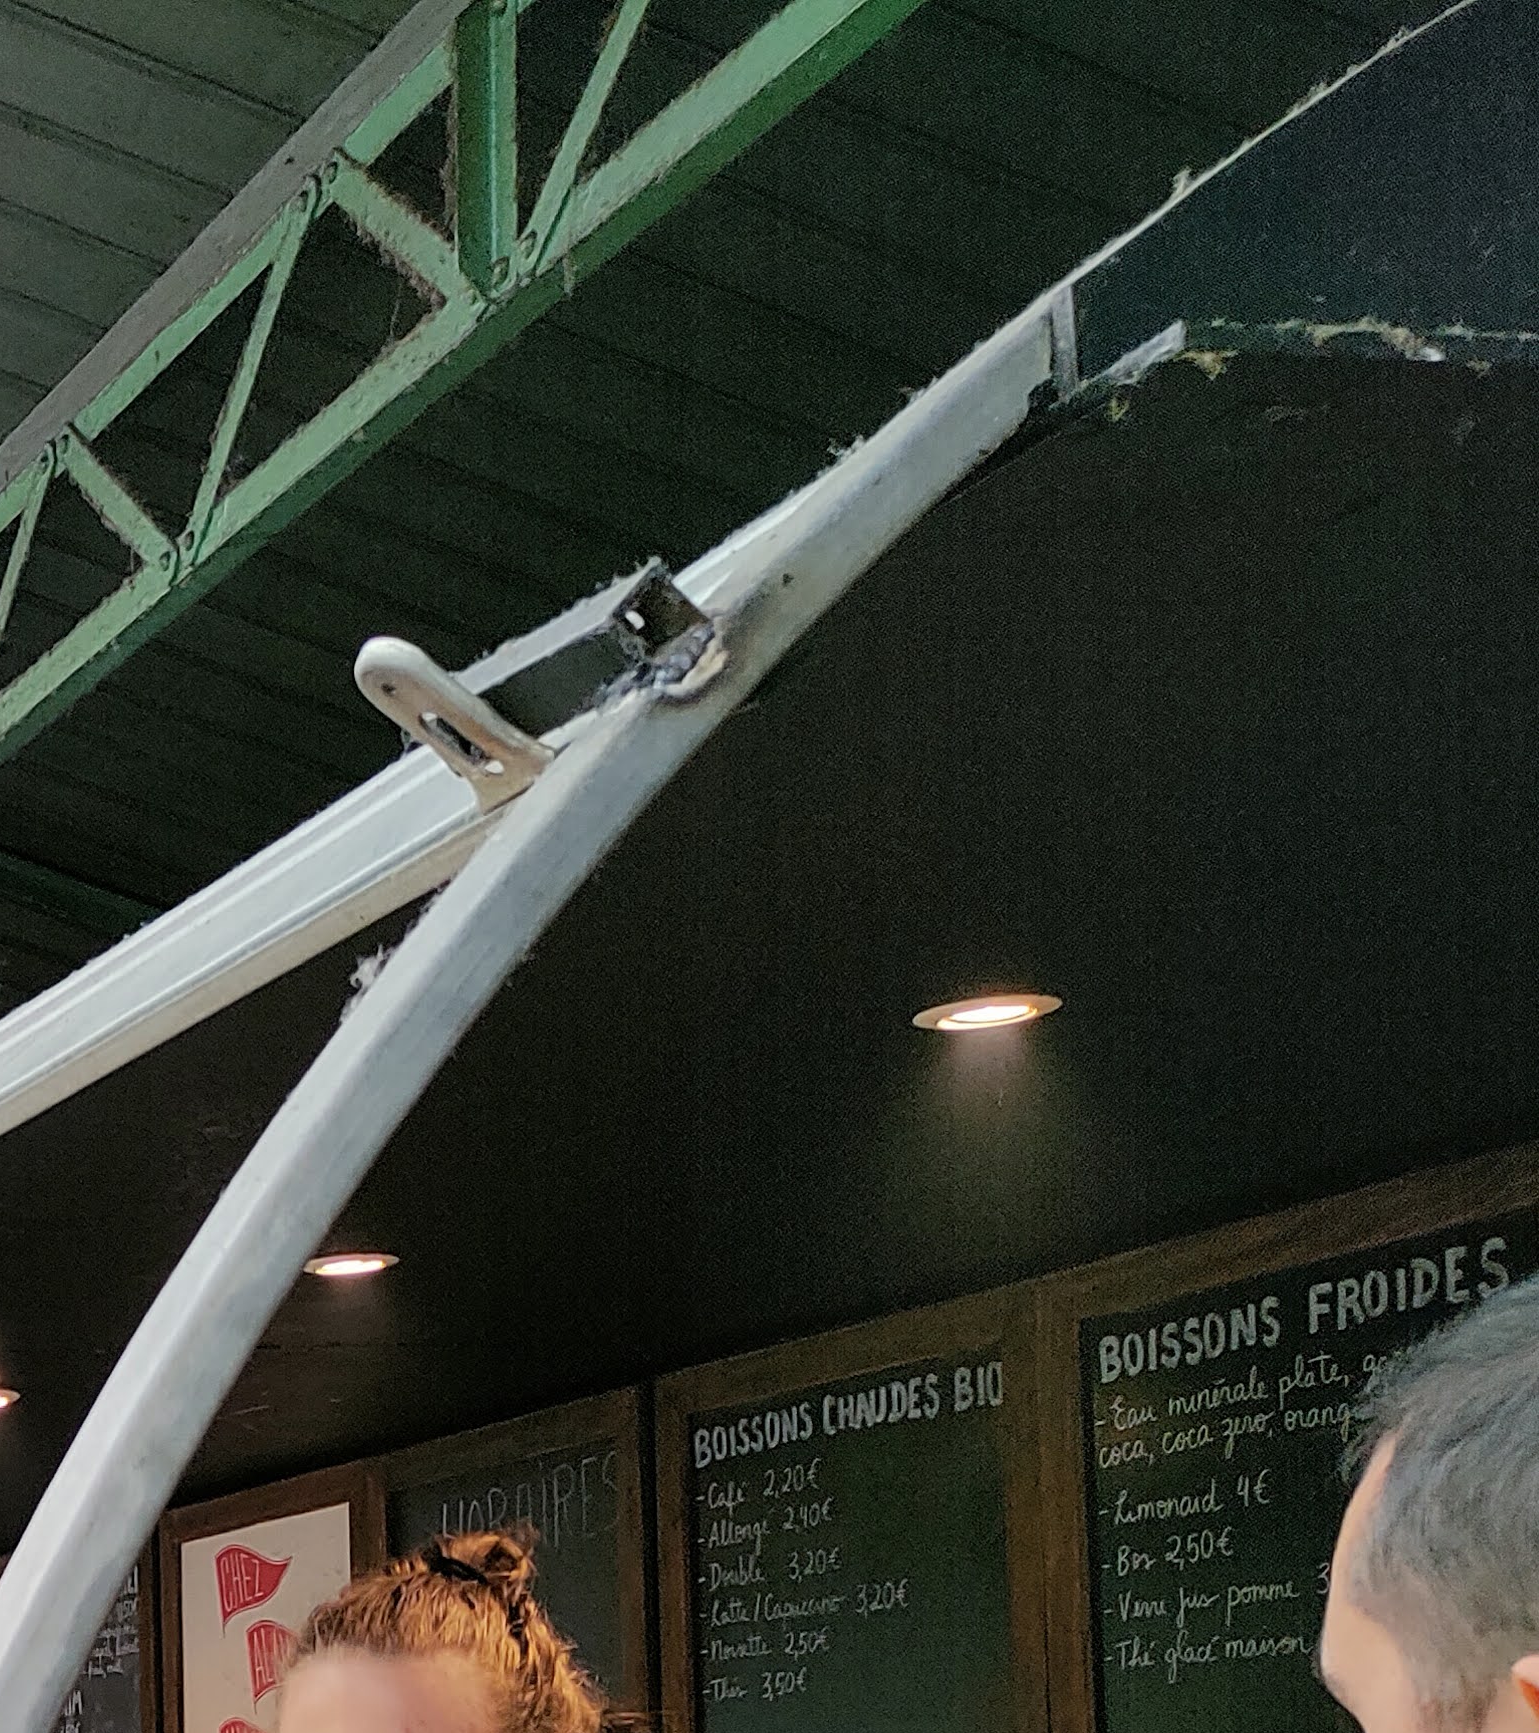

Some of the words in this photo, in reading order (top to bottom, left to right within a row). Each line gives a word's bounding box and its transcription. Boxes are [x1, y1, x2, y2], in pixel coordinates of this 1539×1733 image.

[1098, 1296, 1281, 1384] BOISSONS
[1307, 1236, 1511, 1335] FROIDES
[693, 1400, 814, 1470] BOISSONS
[822, 1373, 941, 1436] CHAUDES
[953, 1360, 1005, 1413] BIO
[1162, 1425, 1214, 1454] coca
[220, 1552, 265, 1613] CHEZ
